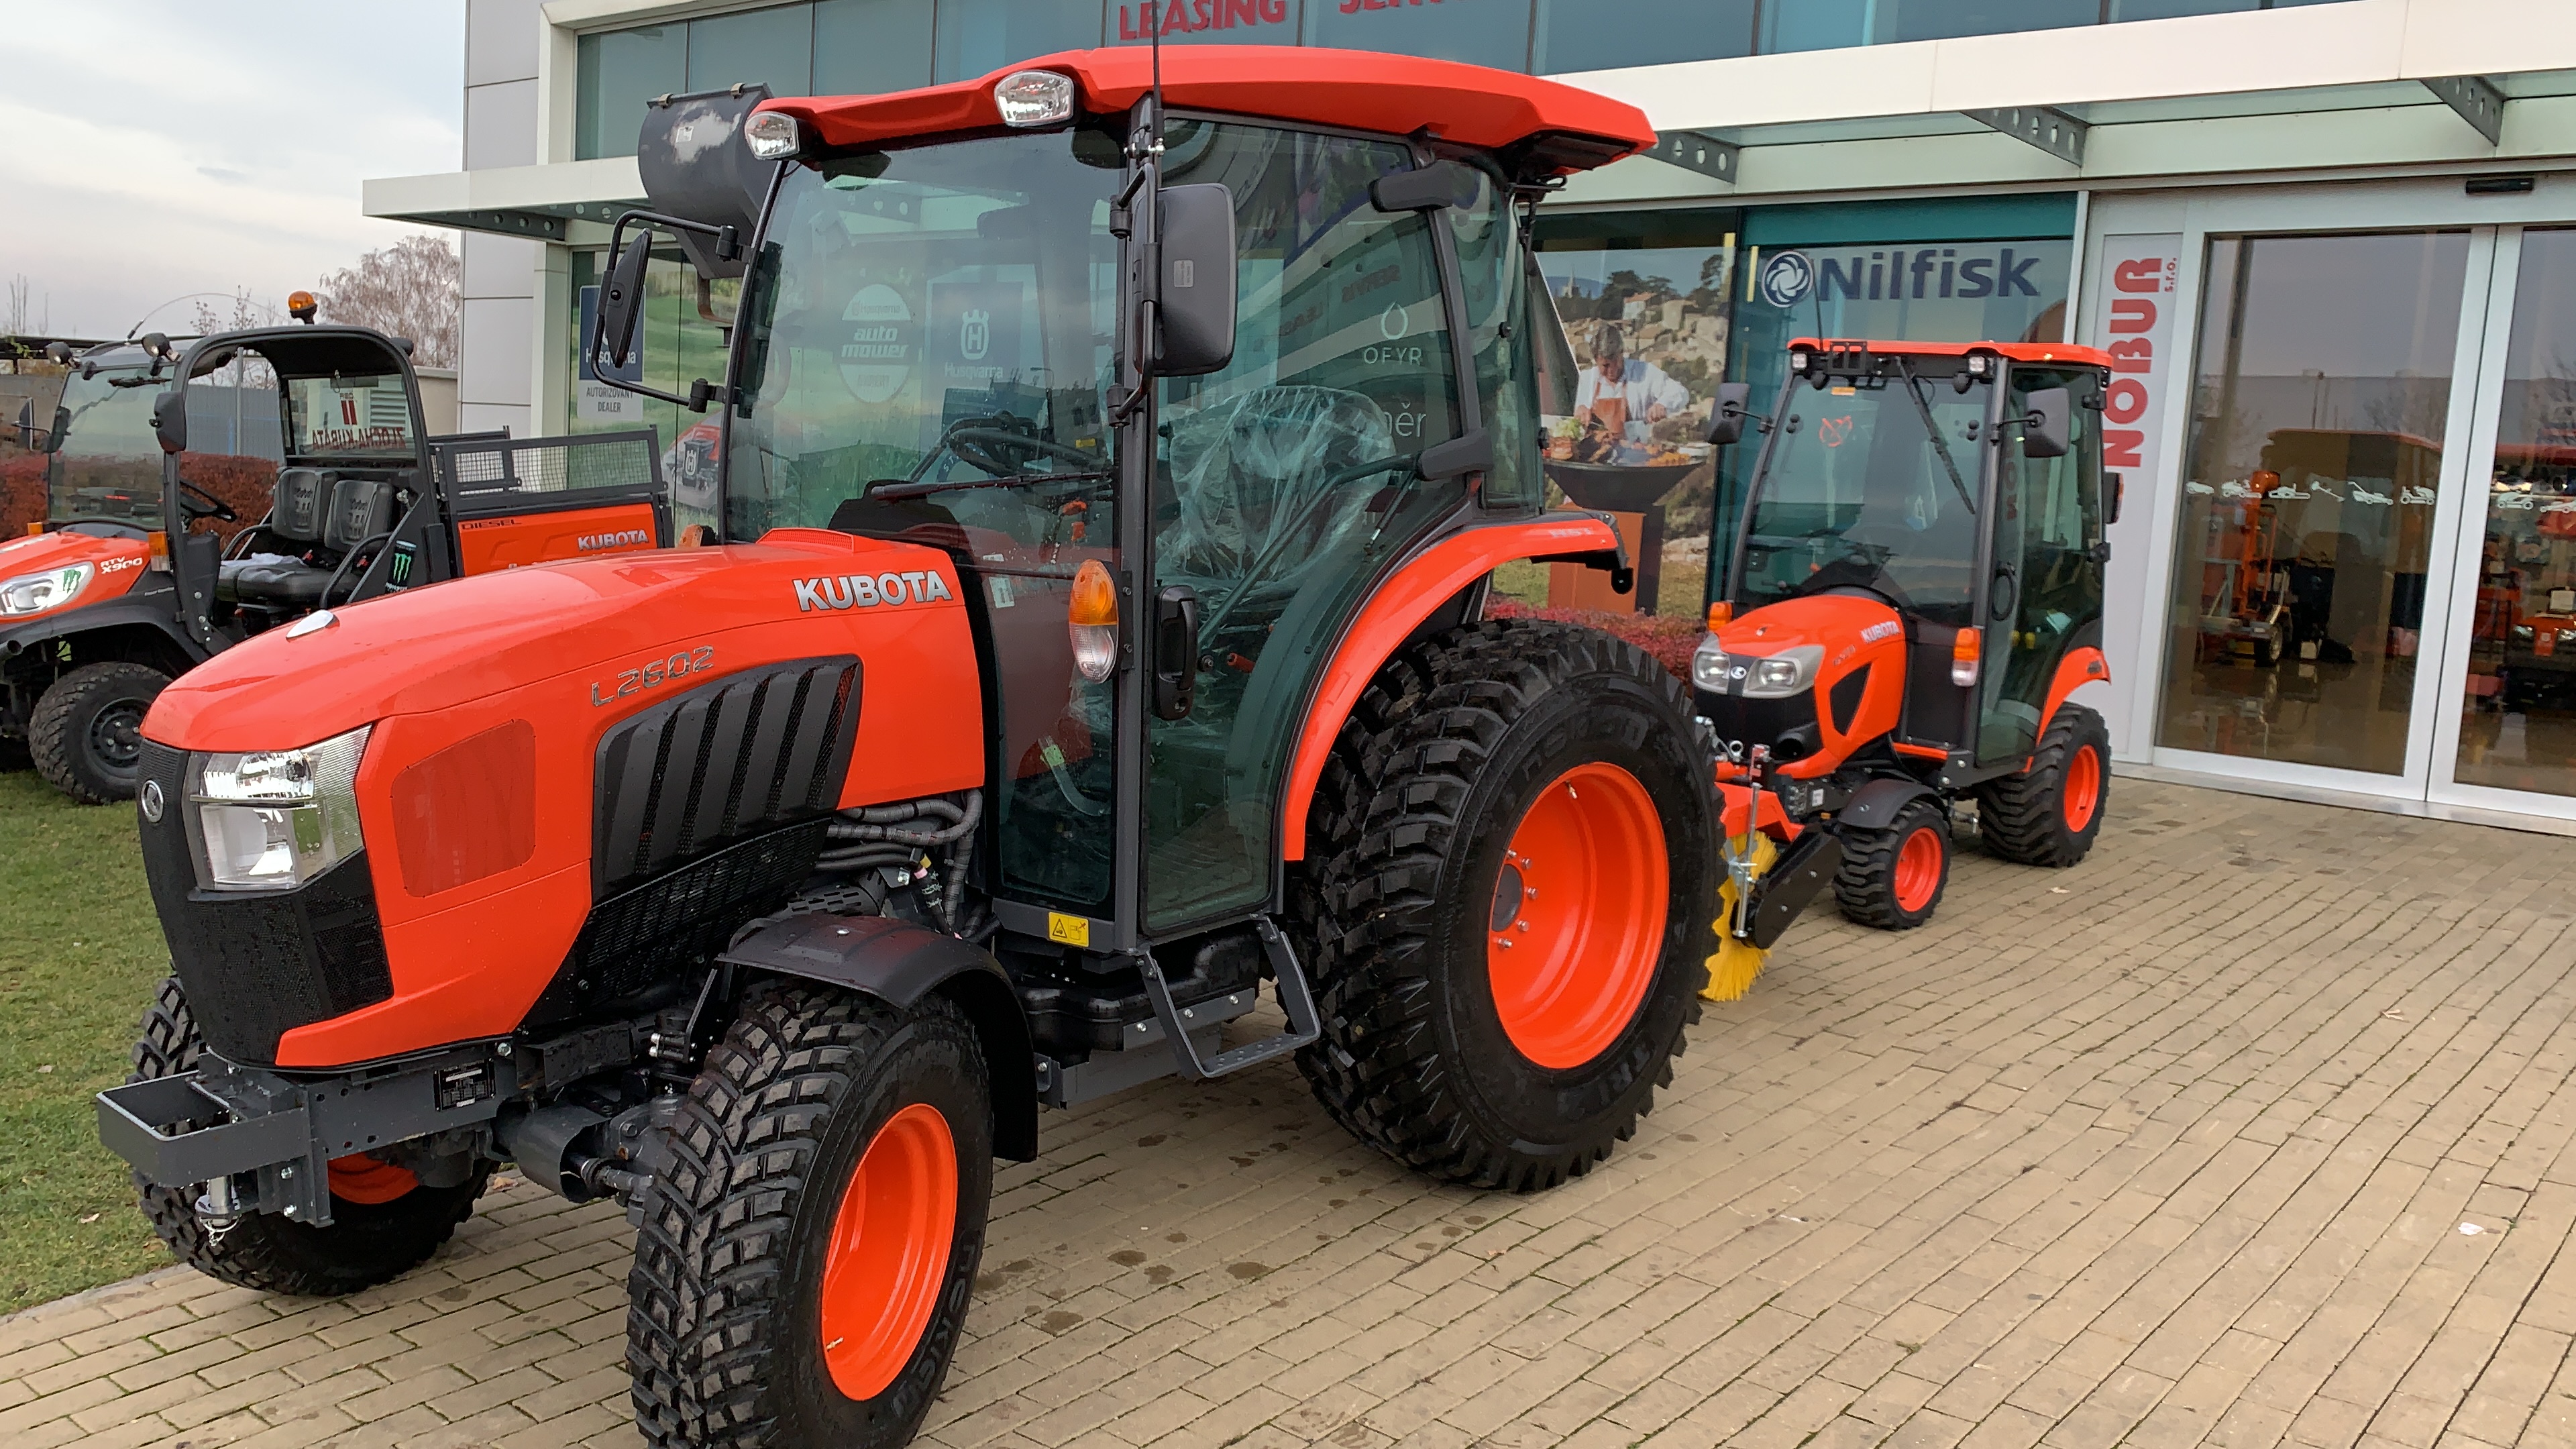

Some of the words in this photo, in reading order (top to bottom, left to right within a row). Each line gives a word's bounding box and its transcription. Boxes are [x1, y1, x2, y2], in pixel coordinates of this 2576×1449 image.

[1120, 0, 1286, 40] LEASING
[1818, 248, 2040, 301] Nilfisk
[2164, 258, 2177, 292] s.r.o.
[853, 326, 898, 341] auto
[586, 347, 636, 366] Hsqna
[841, 344, 908, 358] mower
[1364, 347, 1421, 366] OFYR
[945, 362, 1003, 380] Husqvarna
[2103, 258, 2162, 468] NOBUR
[598, 402, 621, 413] DEALER
[462, 519, 521, 529] DIESEL
[577, 529, 649, 551] KUBOTA
[101, 556, 125, 567] RTV
[101, 557, 143, 574] X900
[792, 570, 953, 612] KUBOTA
[1861, 621, 1900, 643] KUBOTA
[591, 645, 714, 707] L2602
